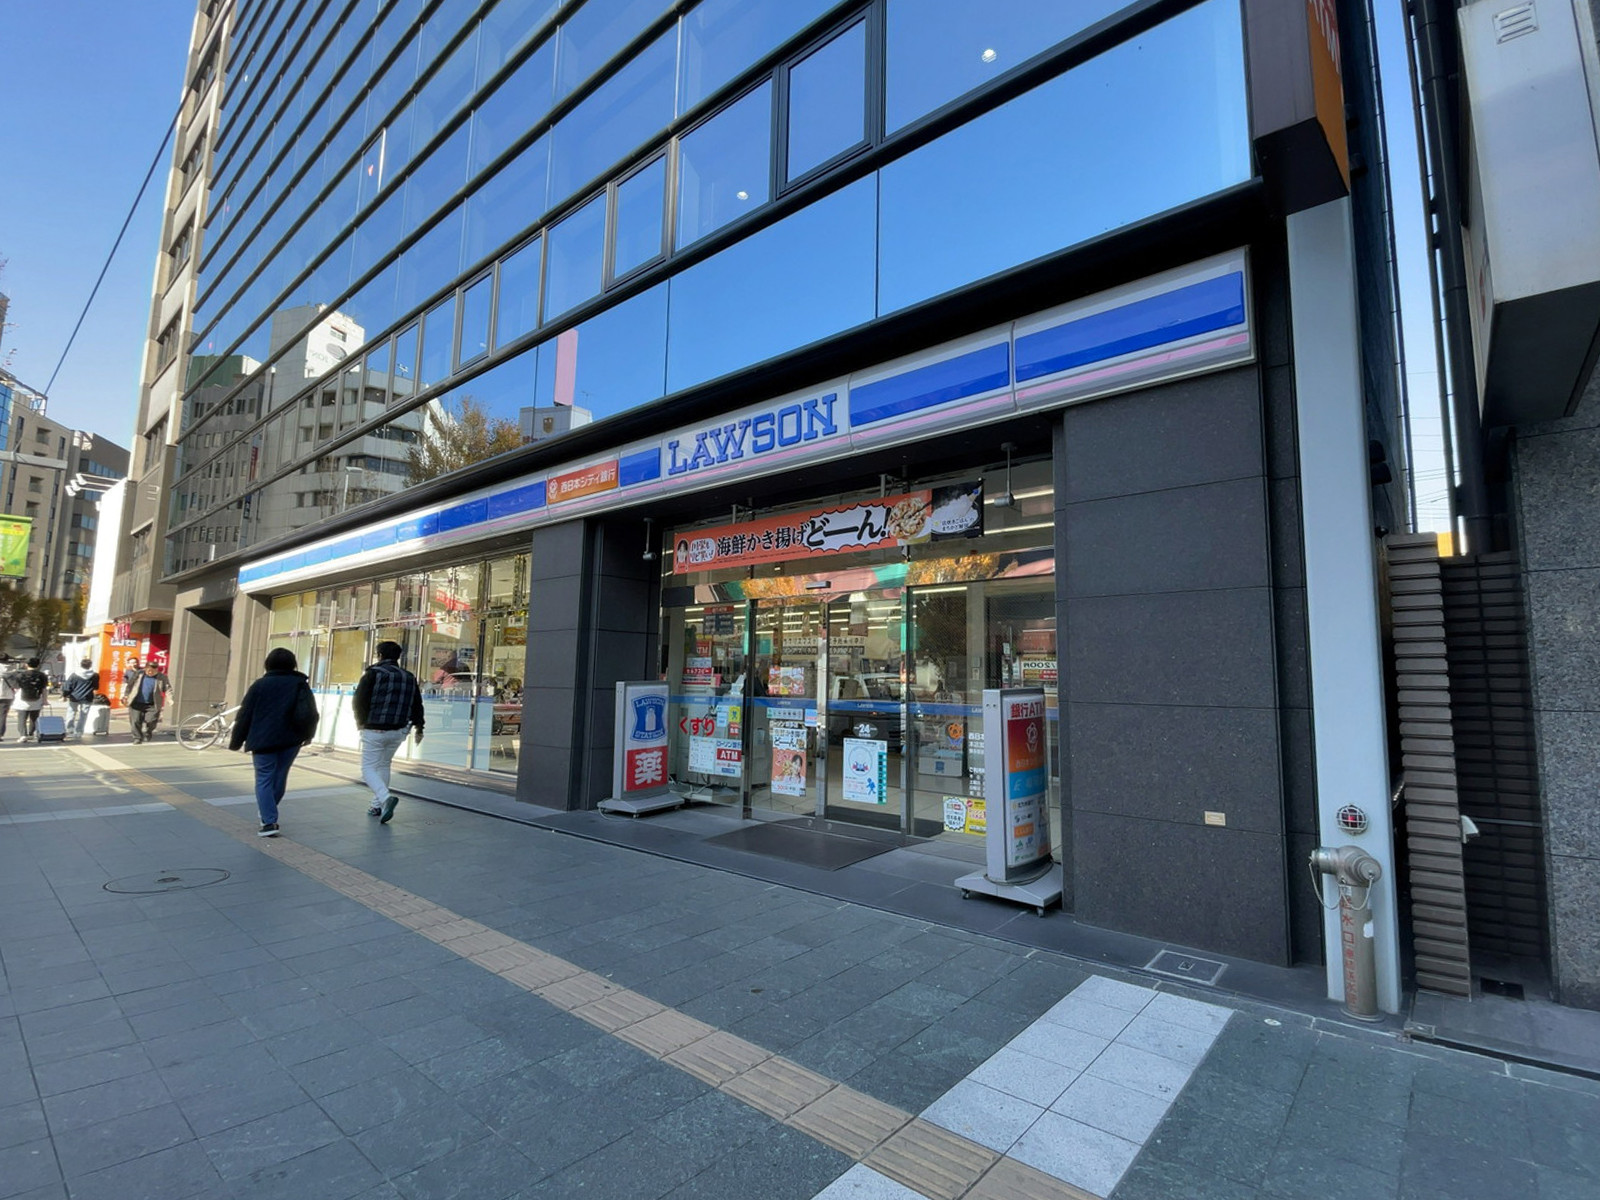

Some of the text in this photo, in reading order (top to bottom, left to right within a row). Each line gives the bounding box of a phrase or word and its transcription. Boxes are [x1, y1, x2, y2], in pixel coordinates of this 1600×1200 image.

[667, 393, 837, 475] LAWSON
[560, 469, 615, 492] 西日本シティ銀行
[679, 717, 715, 737] くすり
[720, 750, 738, 760] ATM
[635, 751, 663, 784] 薬
